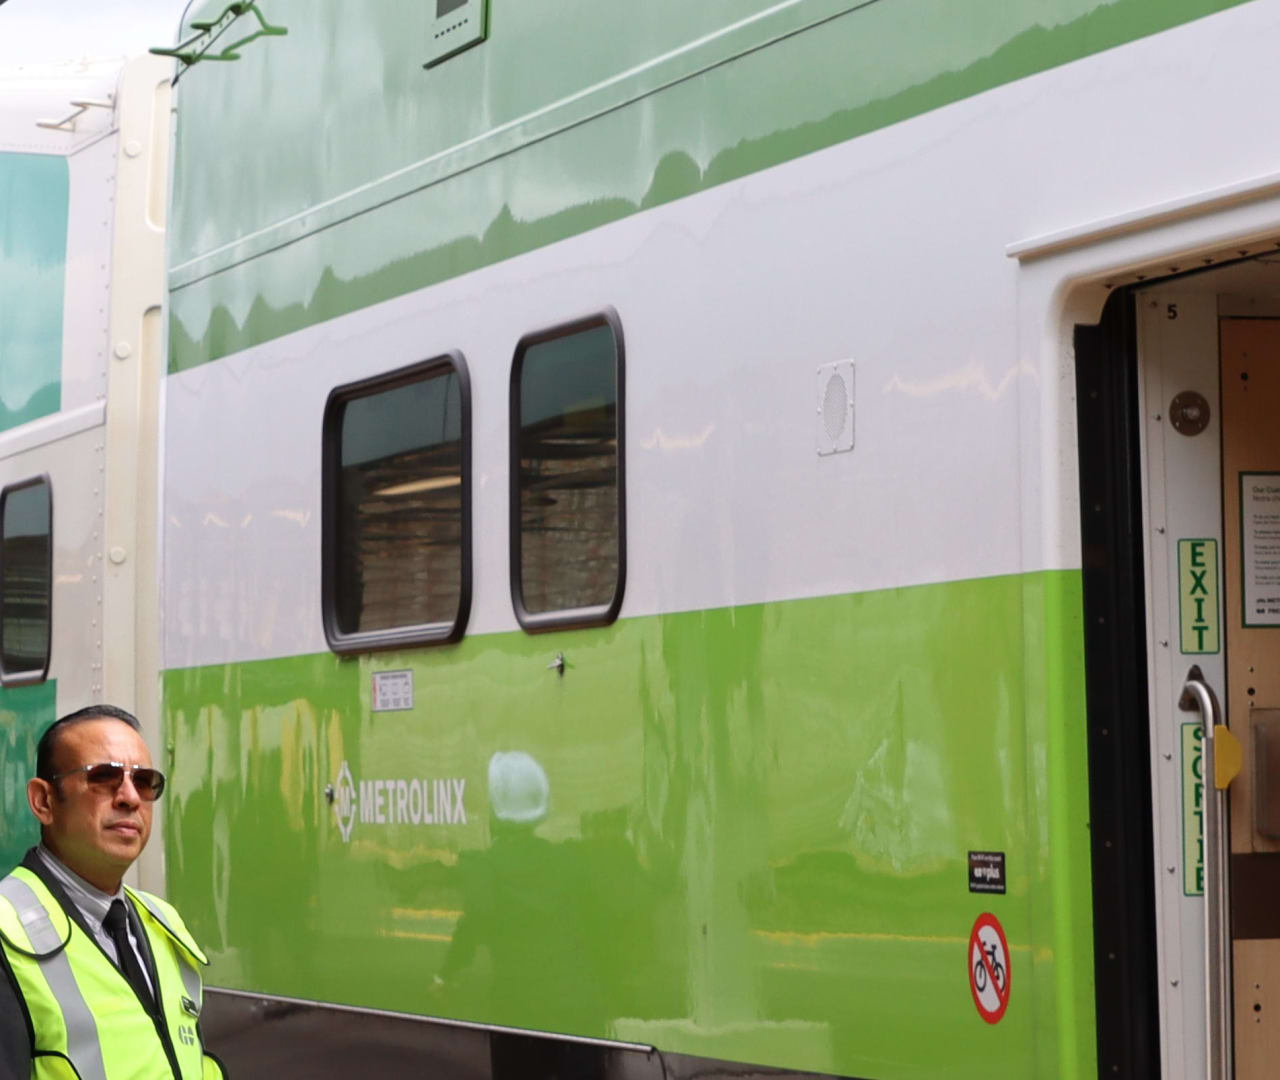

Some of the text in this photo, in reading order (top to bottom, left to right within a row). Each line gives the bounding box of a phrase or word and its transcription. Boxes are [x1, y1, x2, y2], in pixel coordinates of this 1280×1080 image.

[1168, 304, 1178, 320] 5
[1189, 542, 1209, 651] EXIT
[360, 778, 467, 824] METROLINX
